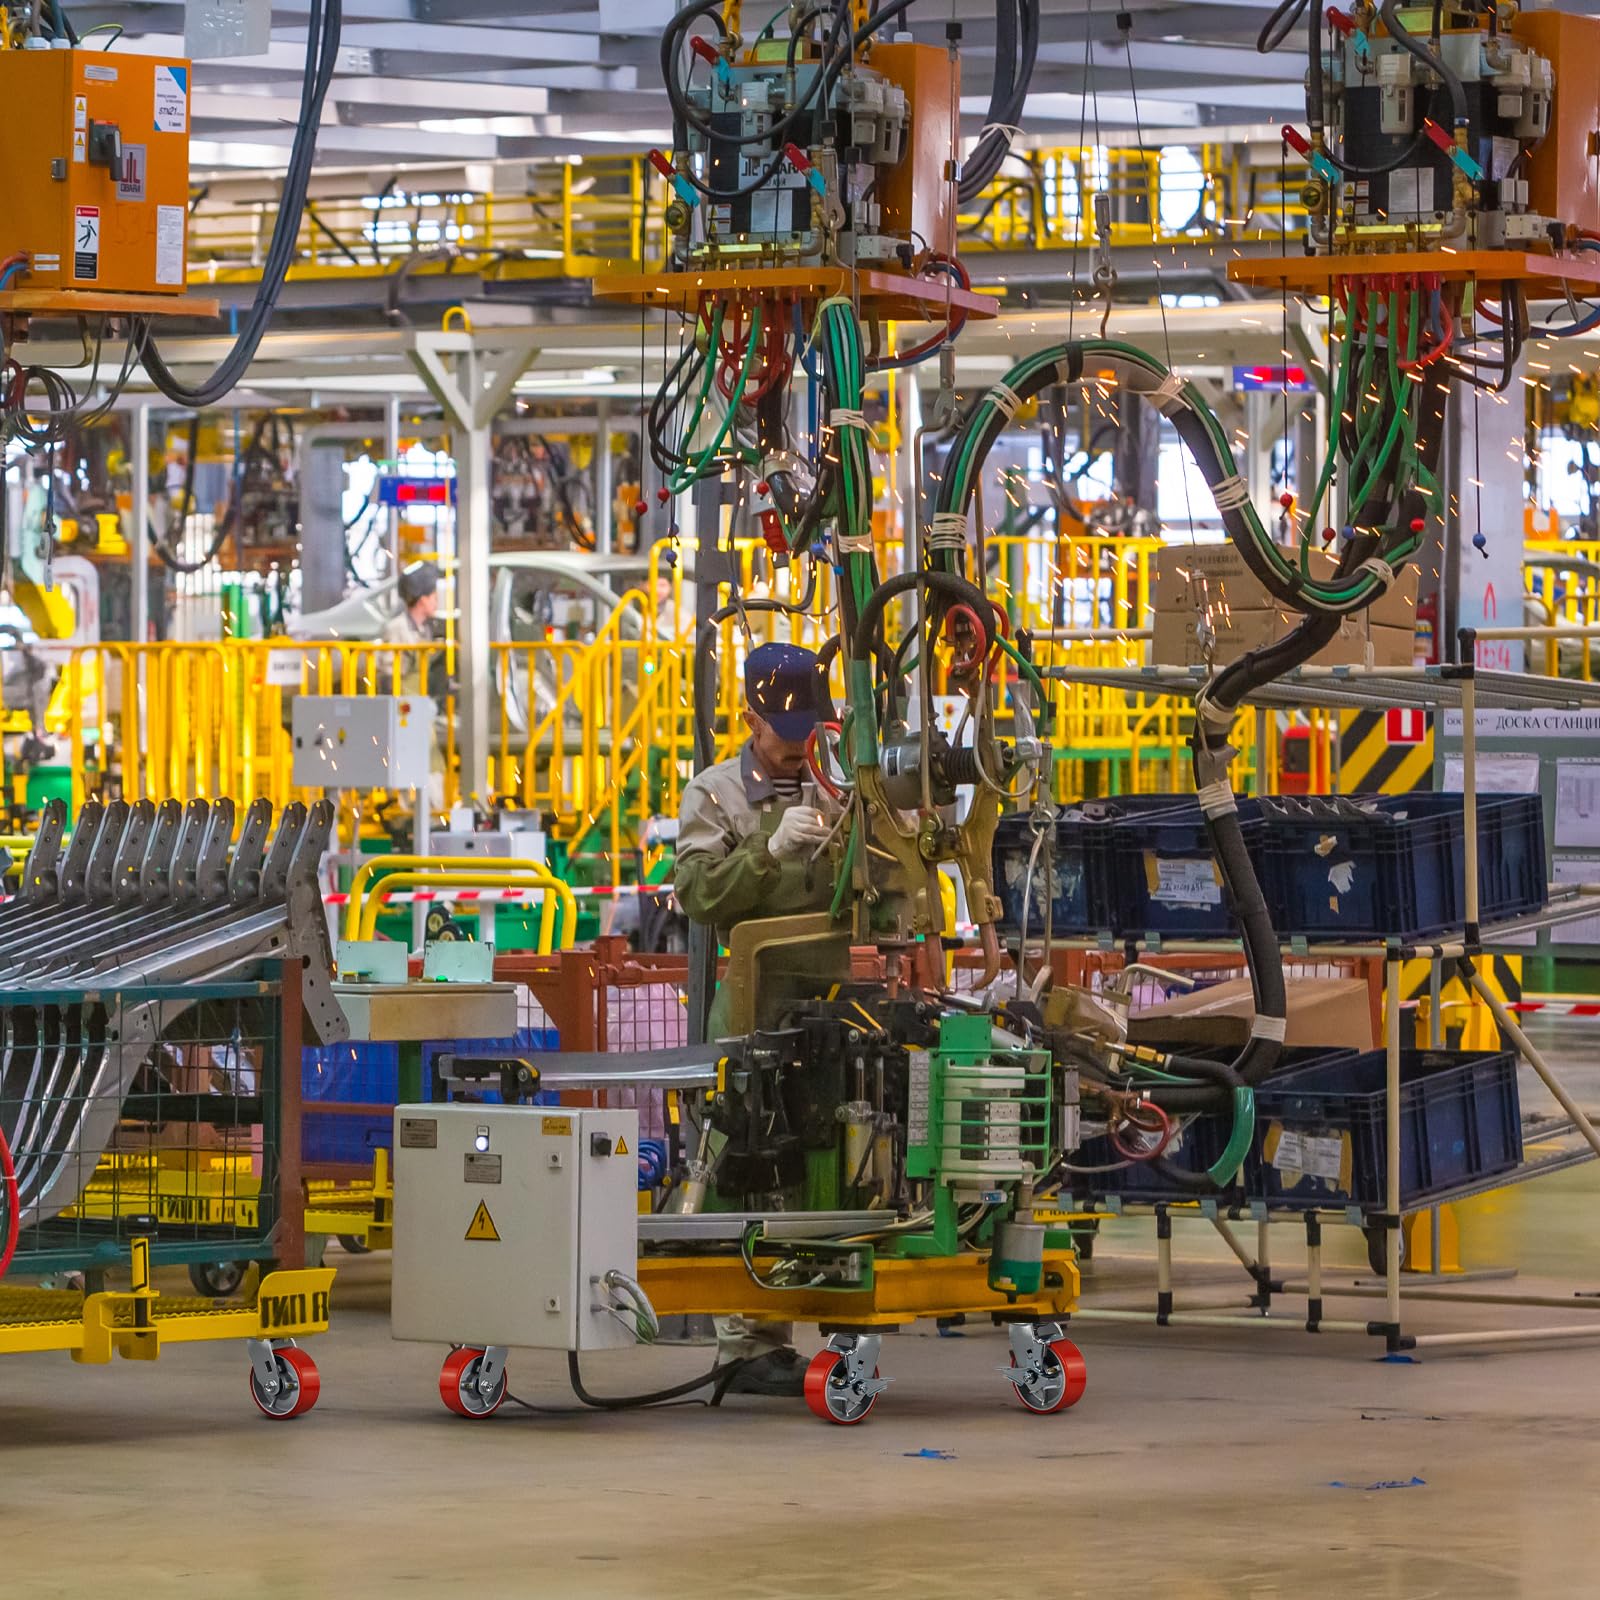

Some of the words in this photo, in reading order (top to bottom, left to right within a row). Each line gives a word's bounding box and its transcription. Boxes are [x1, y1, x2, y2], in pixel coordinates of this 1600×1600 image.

[1496, 716, 1541, 731] ДОСКА
[1544, 716, 1600, 732] СТАНЦИ
[261, 1293, 306, 1328] ТИП
